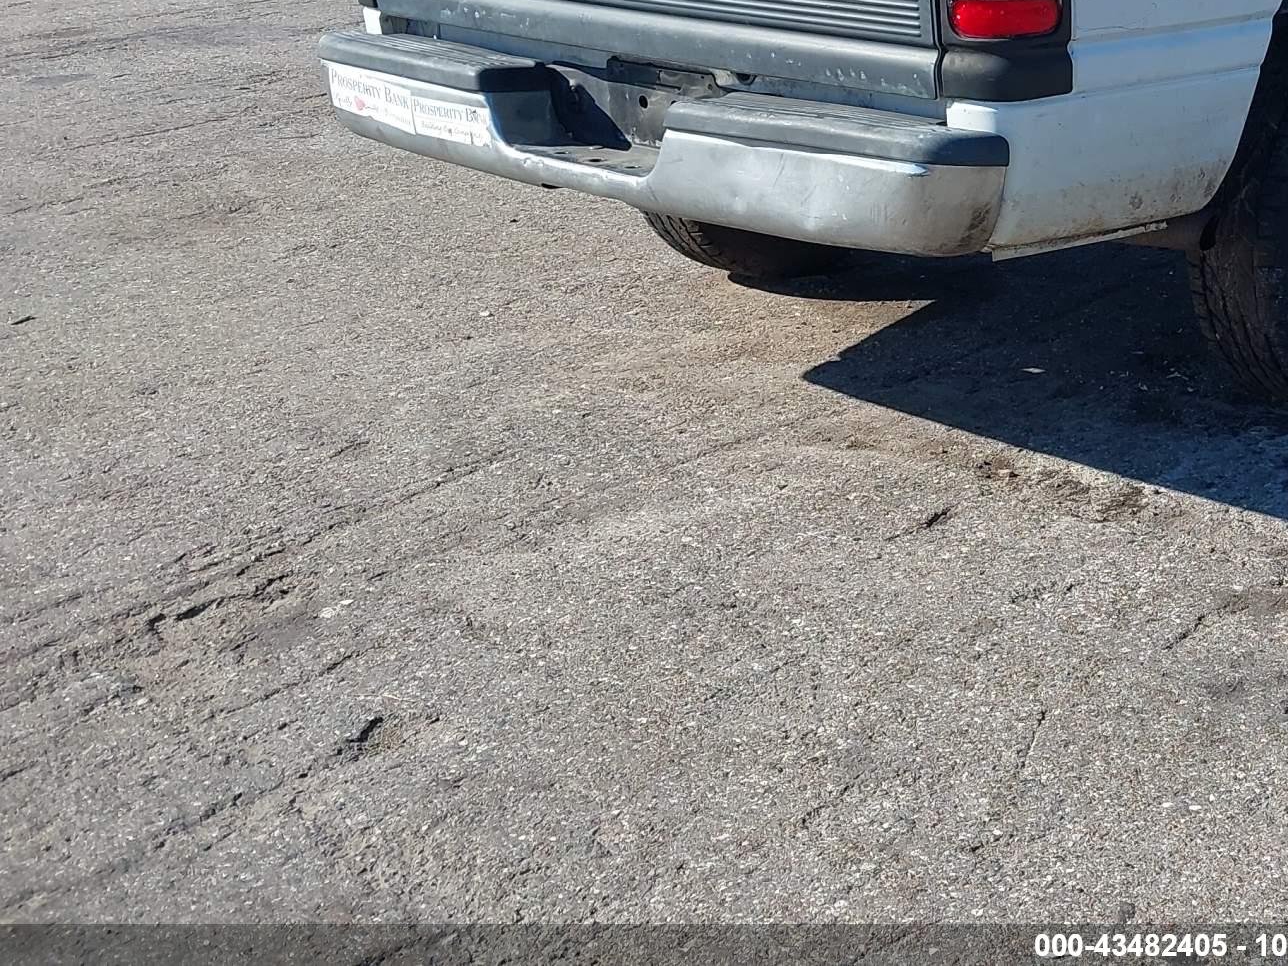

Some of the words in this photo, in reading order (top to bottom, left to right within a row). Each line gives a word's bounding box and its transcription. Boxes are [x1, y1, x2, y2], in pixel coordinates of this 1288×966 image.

[331, 68, 382, 100] PROSPERITY
[384, 86, 410, 110] BANK
[413, 98, 464, 121] PROSPERITY
